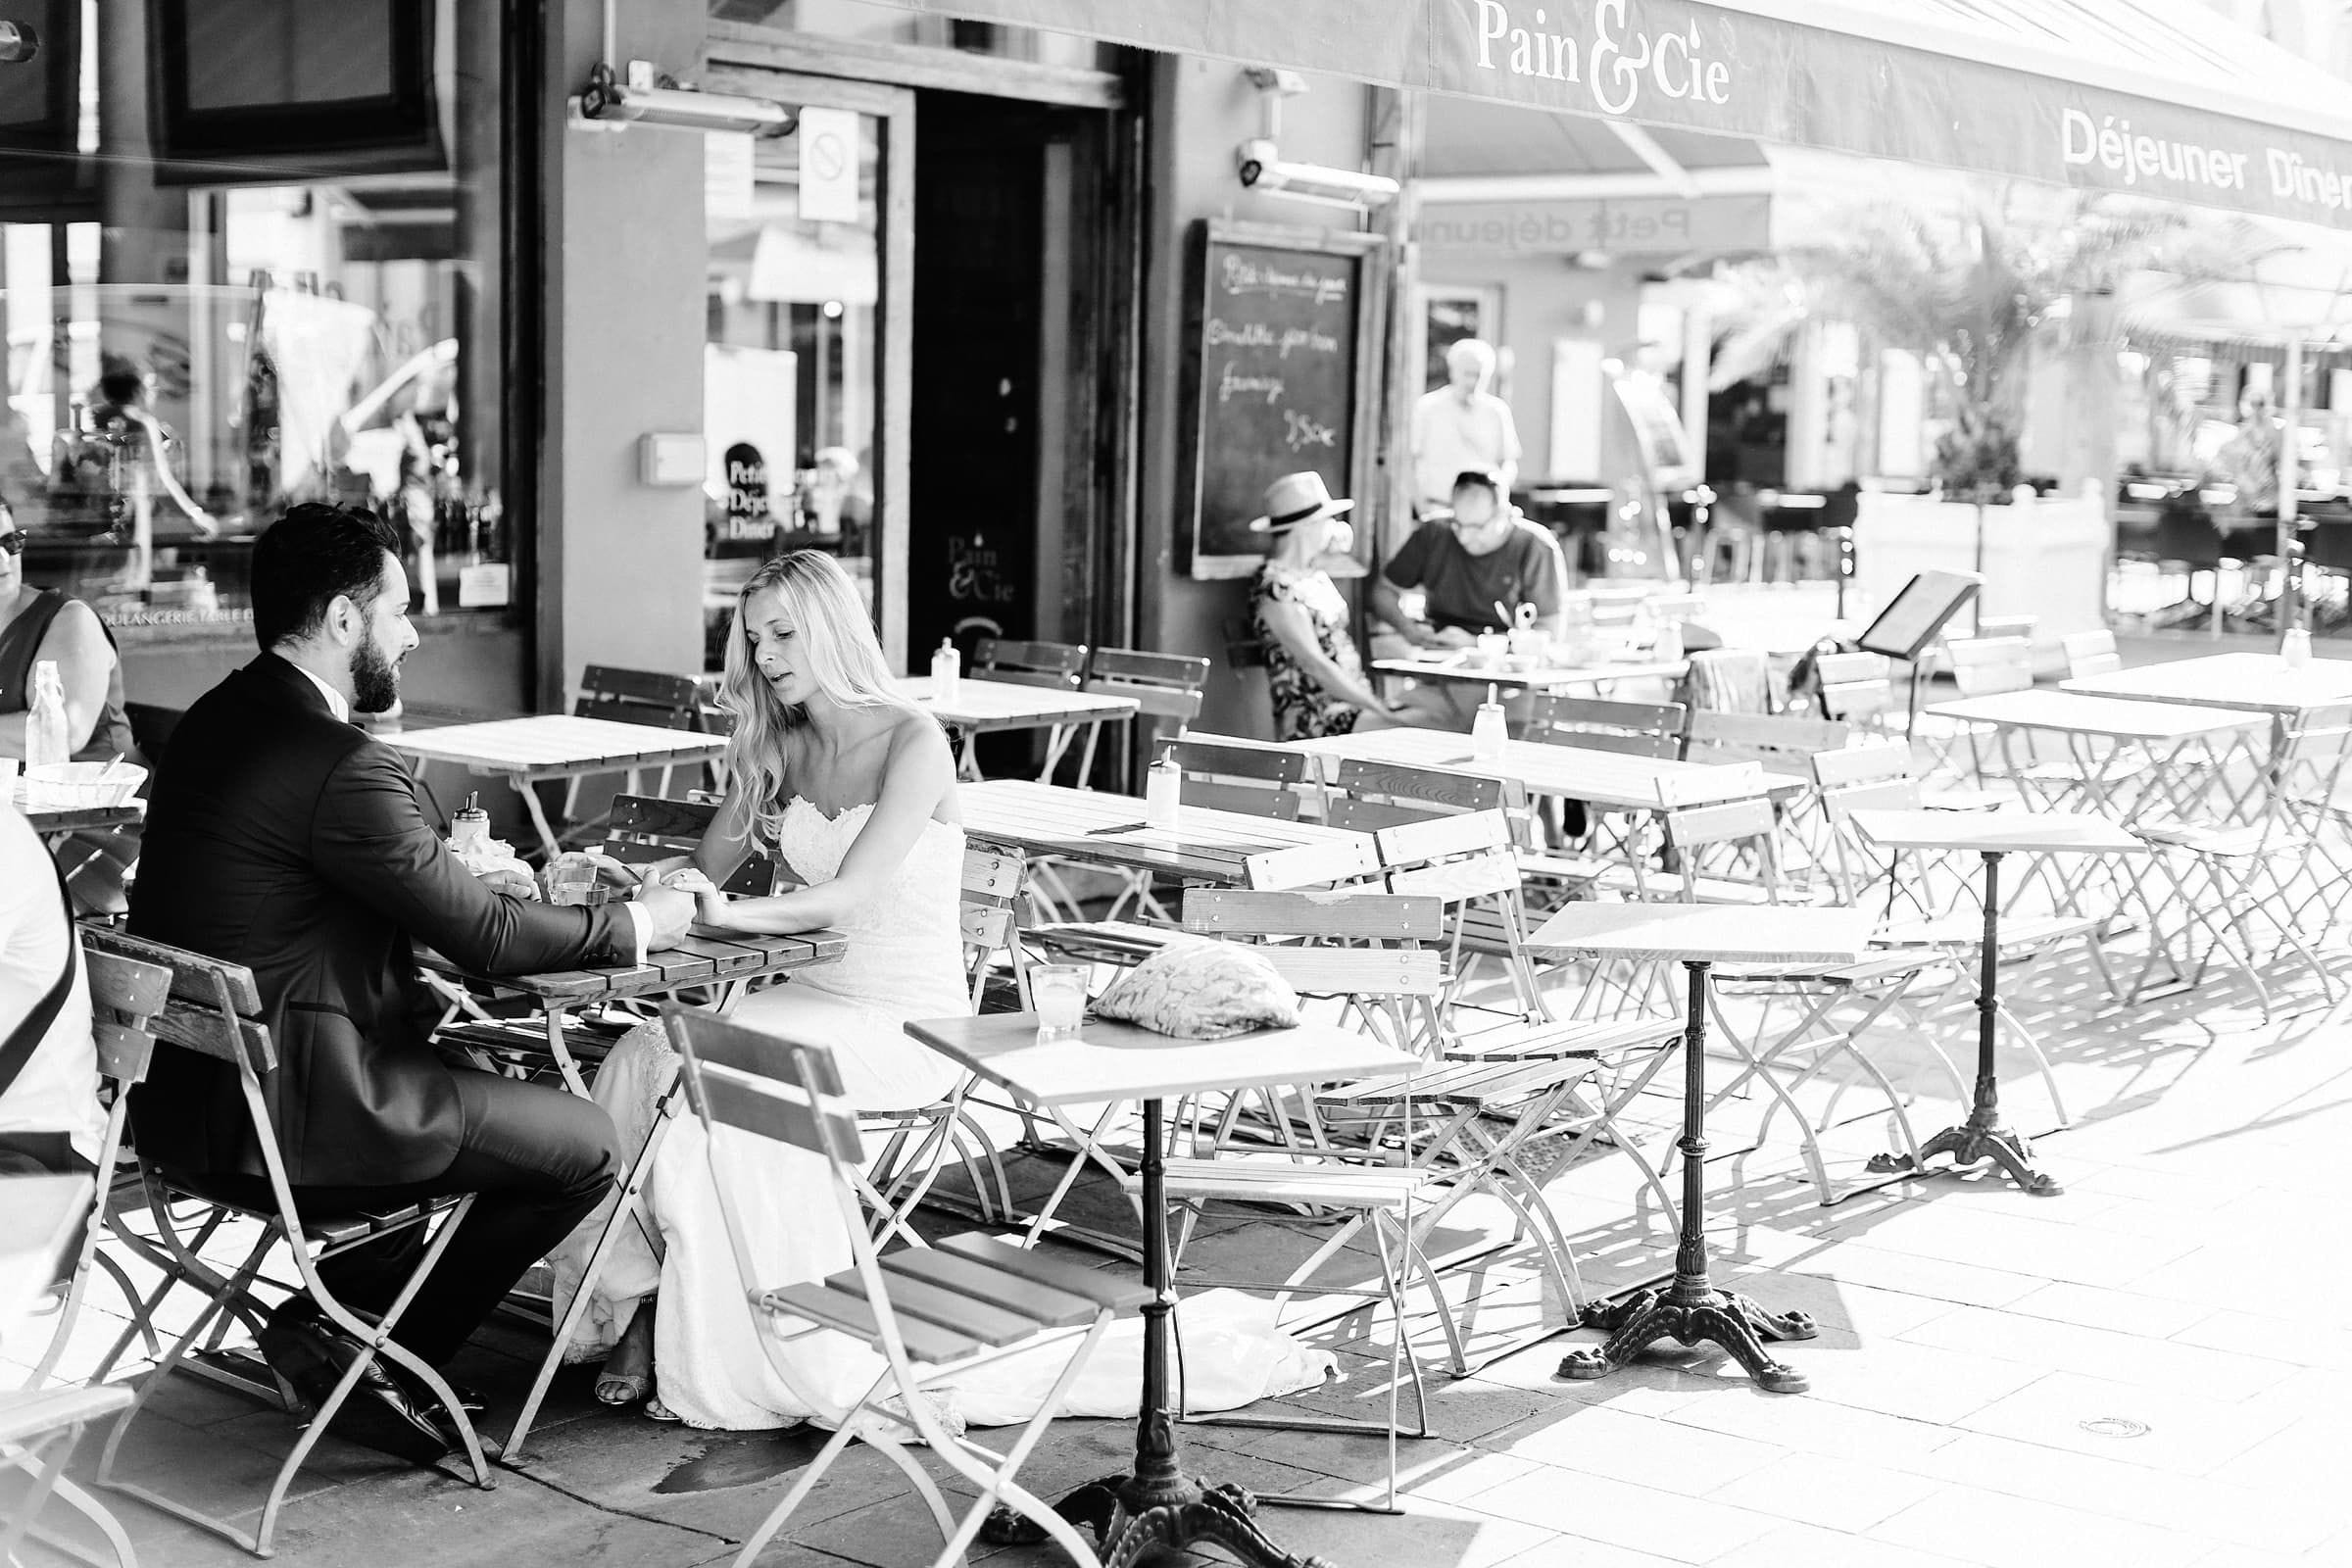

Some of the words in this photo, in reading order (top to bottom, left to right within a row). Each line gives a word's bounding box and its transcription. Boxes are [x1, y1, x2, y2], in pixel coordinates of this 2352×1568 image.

[1477, 0, 1580, 82] Pain
[1590, 0, 1650, 115] &
[1652, 17, 1730, 104] Cie
[2063, 109, 2247, 189] Déjeuner
[102, 610, 196, 626] OULANGERIE
